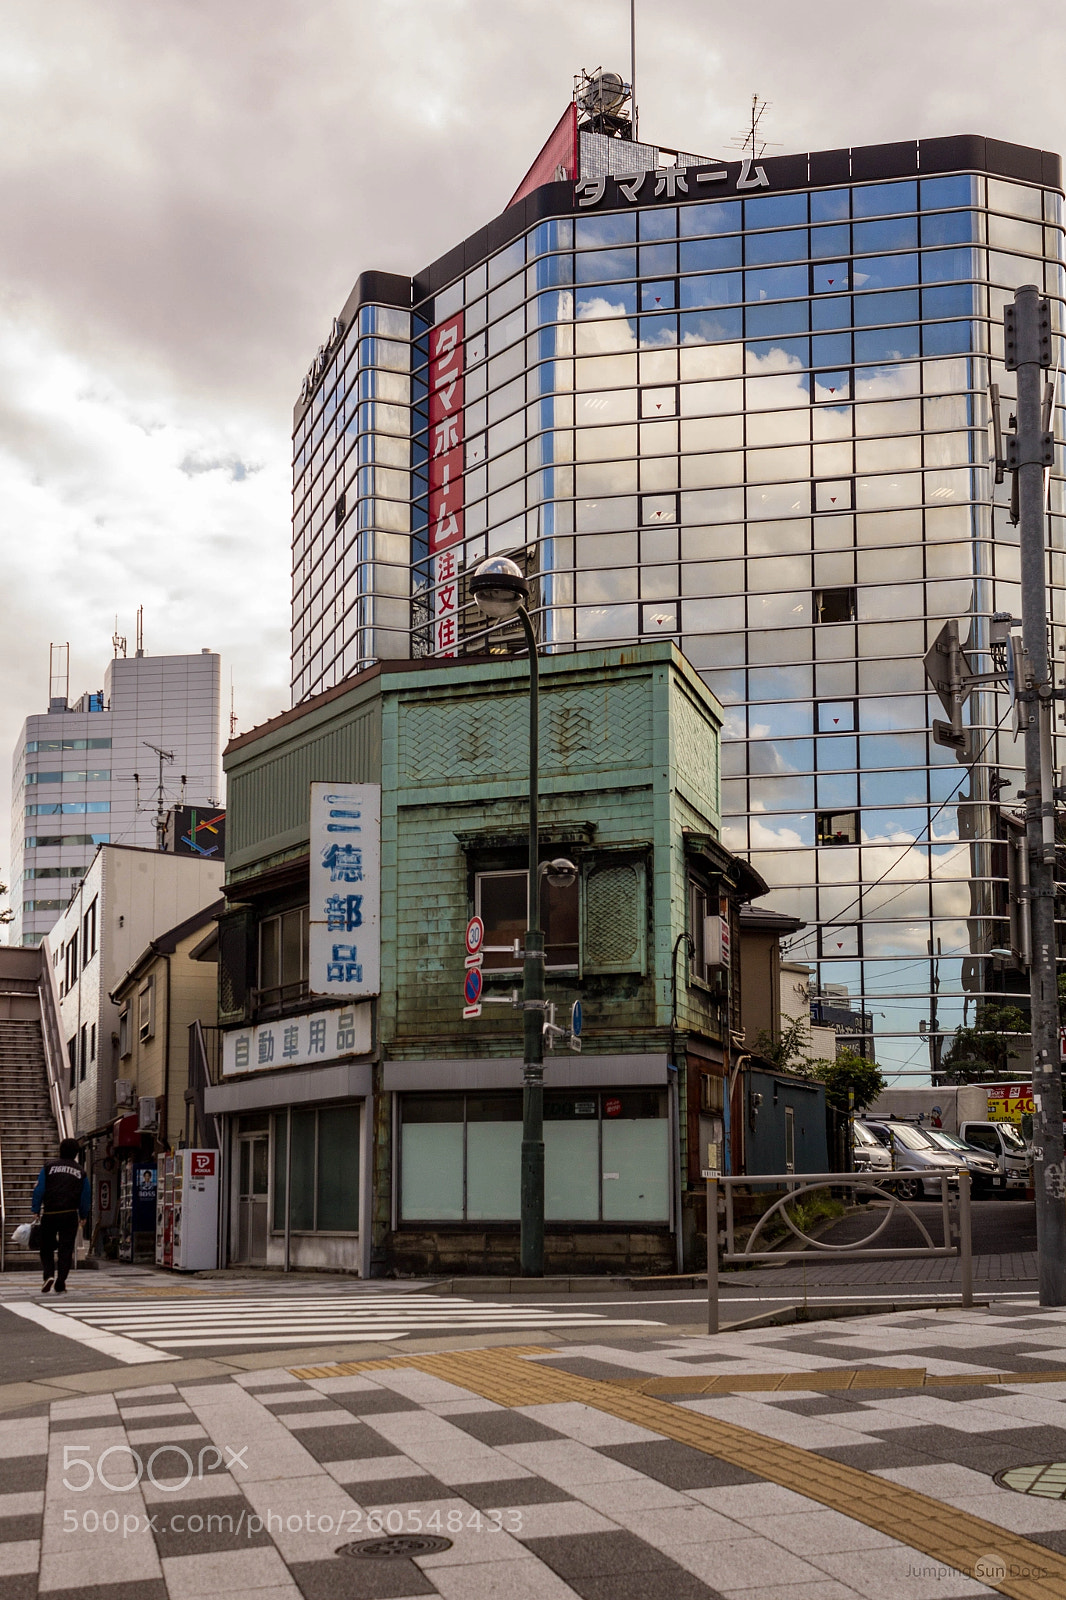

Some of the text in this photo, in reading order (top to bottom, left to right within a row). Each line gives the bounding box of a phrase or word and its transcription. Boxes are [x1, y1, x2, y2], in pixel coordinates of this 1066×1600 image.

[575, 159, 770, 207] タマホーム
[433, 323, 459, 543] タマホーム
[470, 927, 479, 944] 30
[235, 1012, 356, 1068] 自動車用品
[49, 1166, 82, 1179] FIGHTERS
